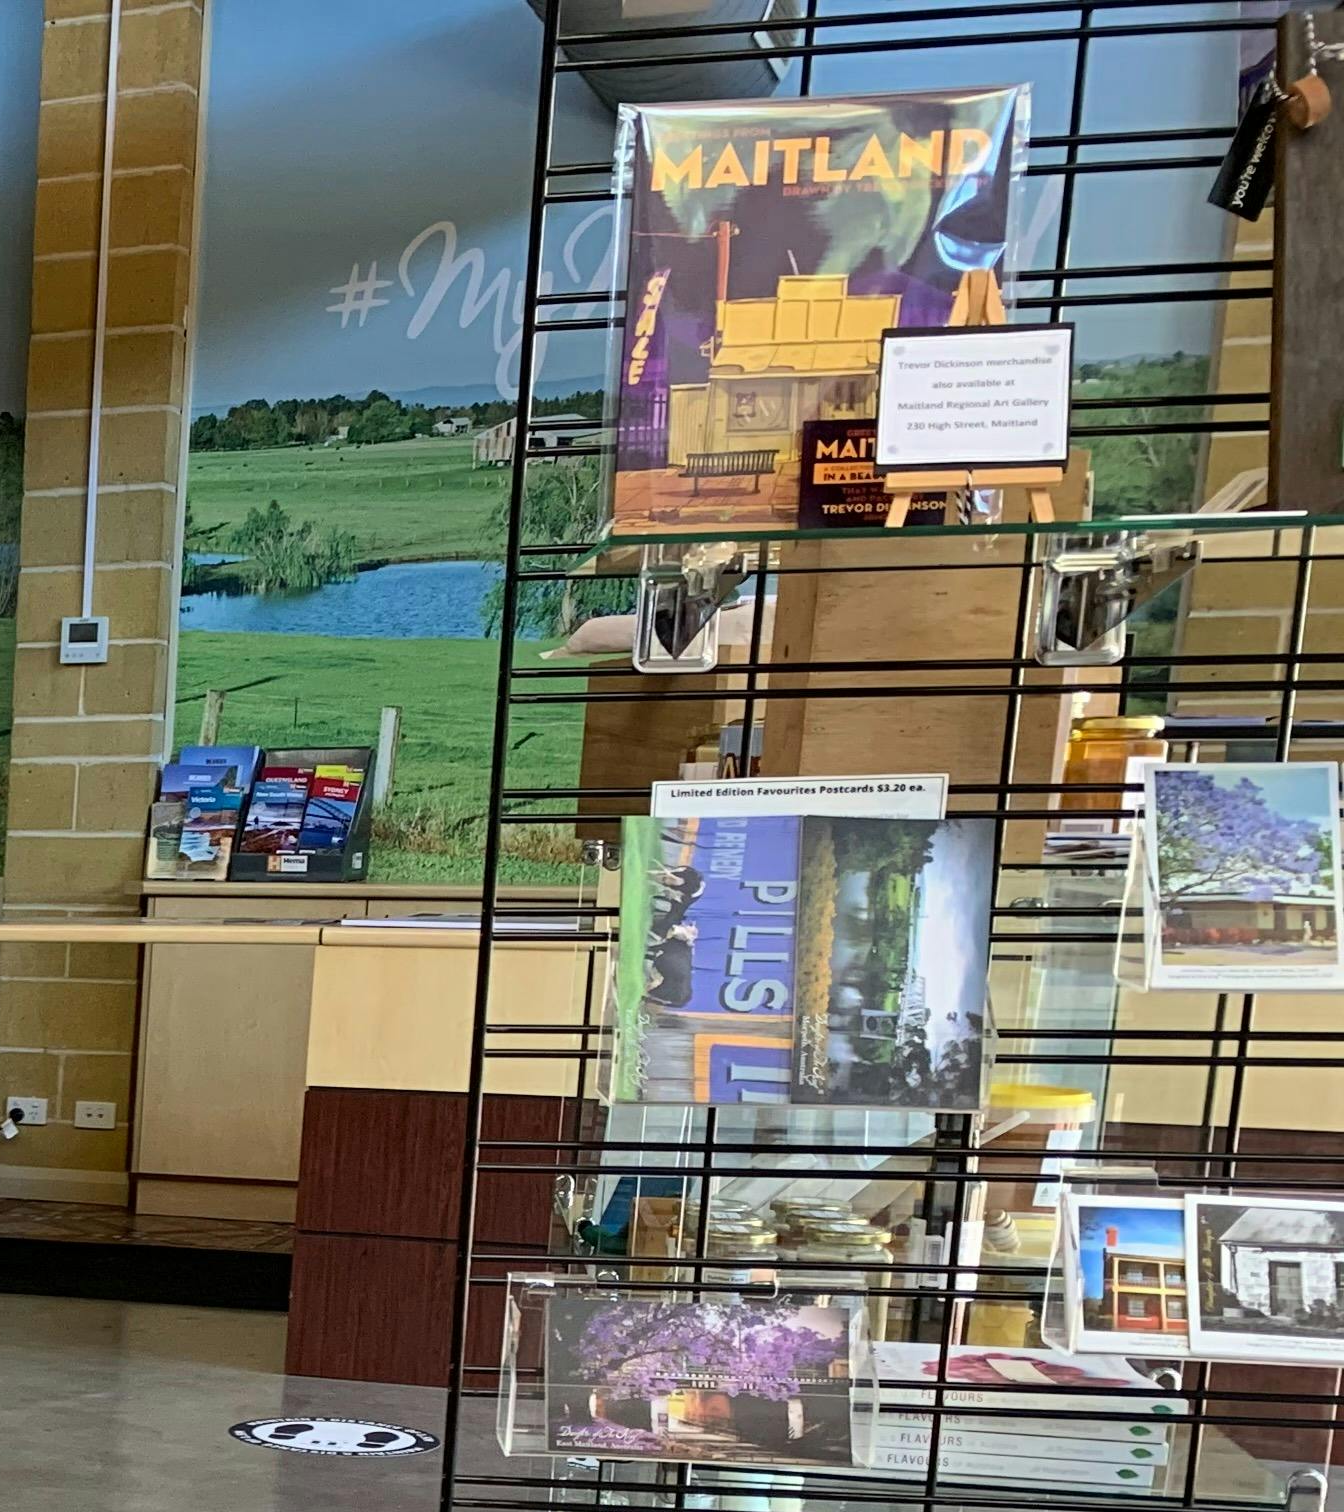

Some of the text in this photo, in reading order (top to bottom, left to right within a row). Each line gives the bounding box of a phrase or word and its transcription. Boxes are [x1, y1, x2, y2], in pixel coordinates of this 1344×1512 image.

[650, 128, 994, 192] MAITLAND
[898, 356, 1053, 370] Trevor Dickinson merchandise
[932, 378, 1015, 389] also available at
[897, 398, 1049, 411] Maitland Regional Art Gallery
[906, 418, 1038, 432] 230 High Street, Maitland
[822, 503, 874, 515] TREVOR
[323, 786, 350, 794] SYDNEY
[670, 782, 926, 799] Limited Edition Favourites Postcards $3.20 ea.
[191, 796, 216, 804] Victoria
[283, 857, 306, 865] Hema
[709, 832, 747, 881] REMEDY
[721, 880, 797, 1013] PILLS
